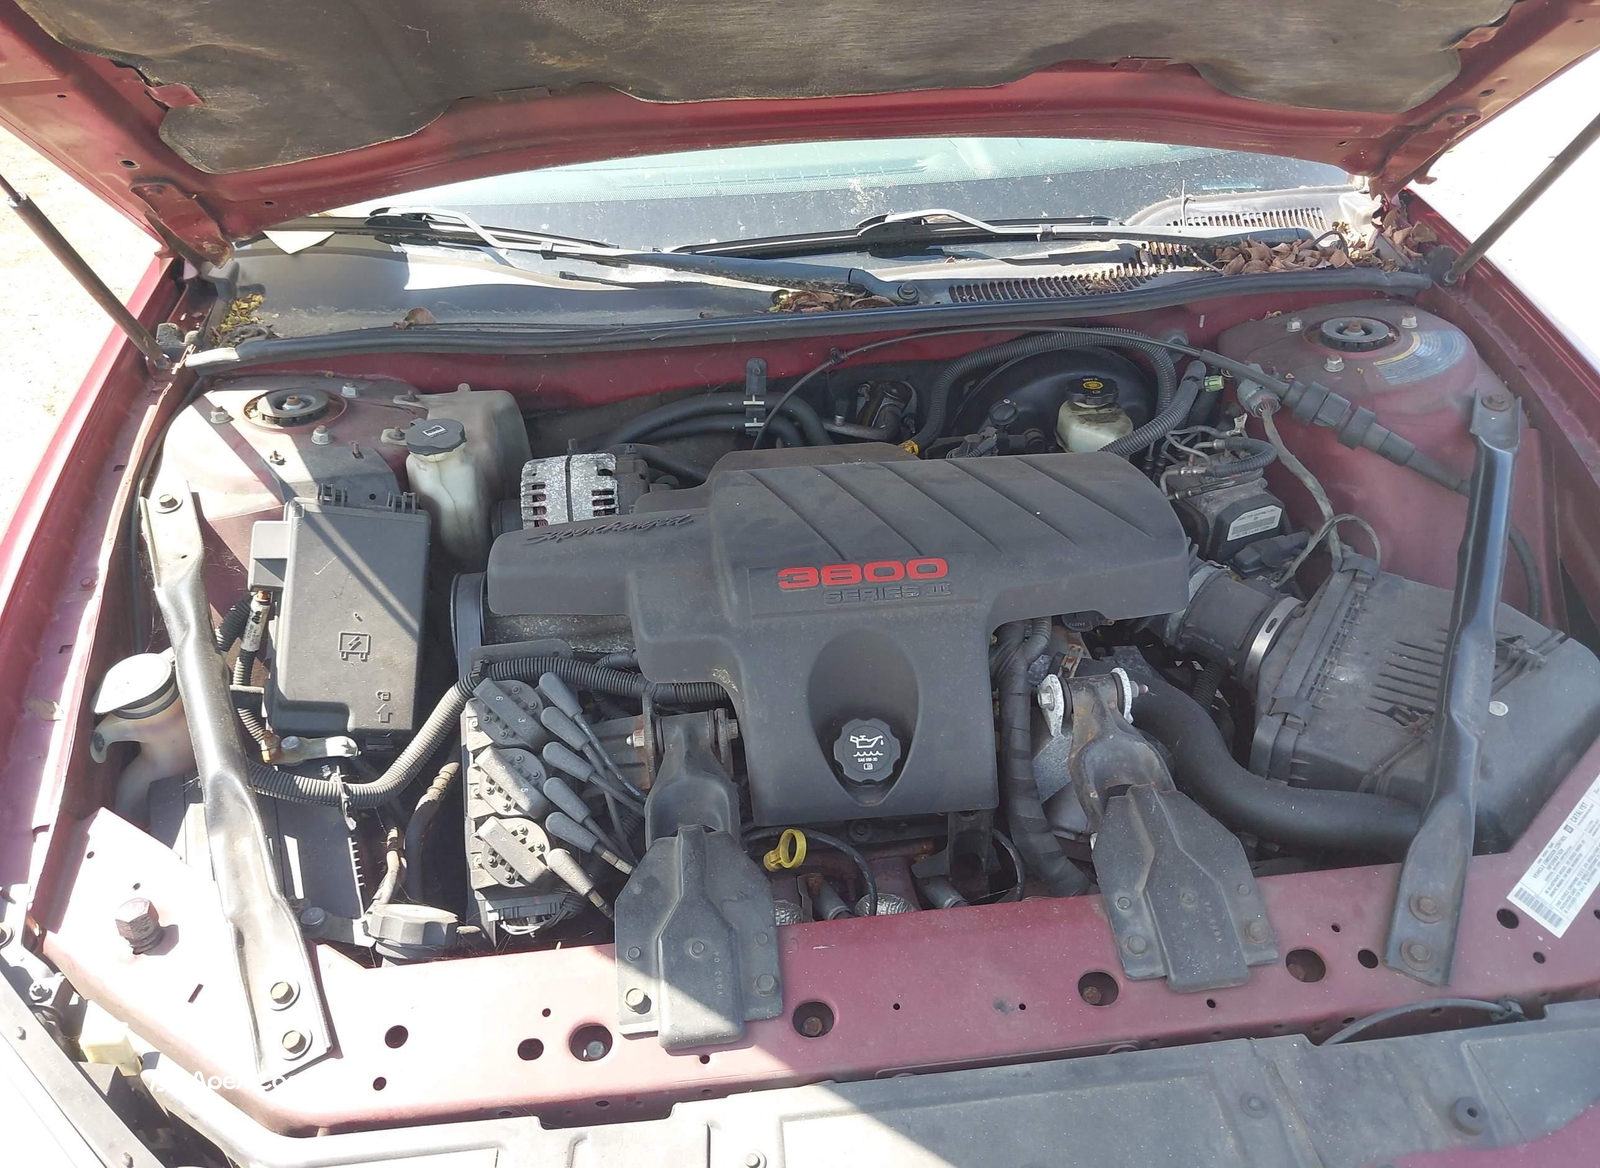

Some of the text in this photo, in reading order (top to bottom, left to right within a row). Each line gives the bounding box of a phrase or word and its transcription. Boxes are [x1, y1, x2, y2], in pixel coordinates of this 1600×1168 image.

[777, 558, 948, 590] 3800
[823, 585, 920, 604] SERIES
[1570, 801, 1588, 823] CATALYST
